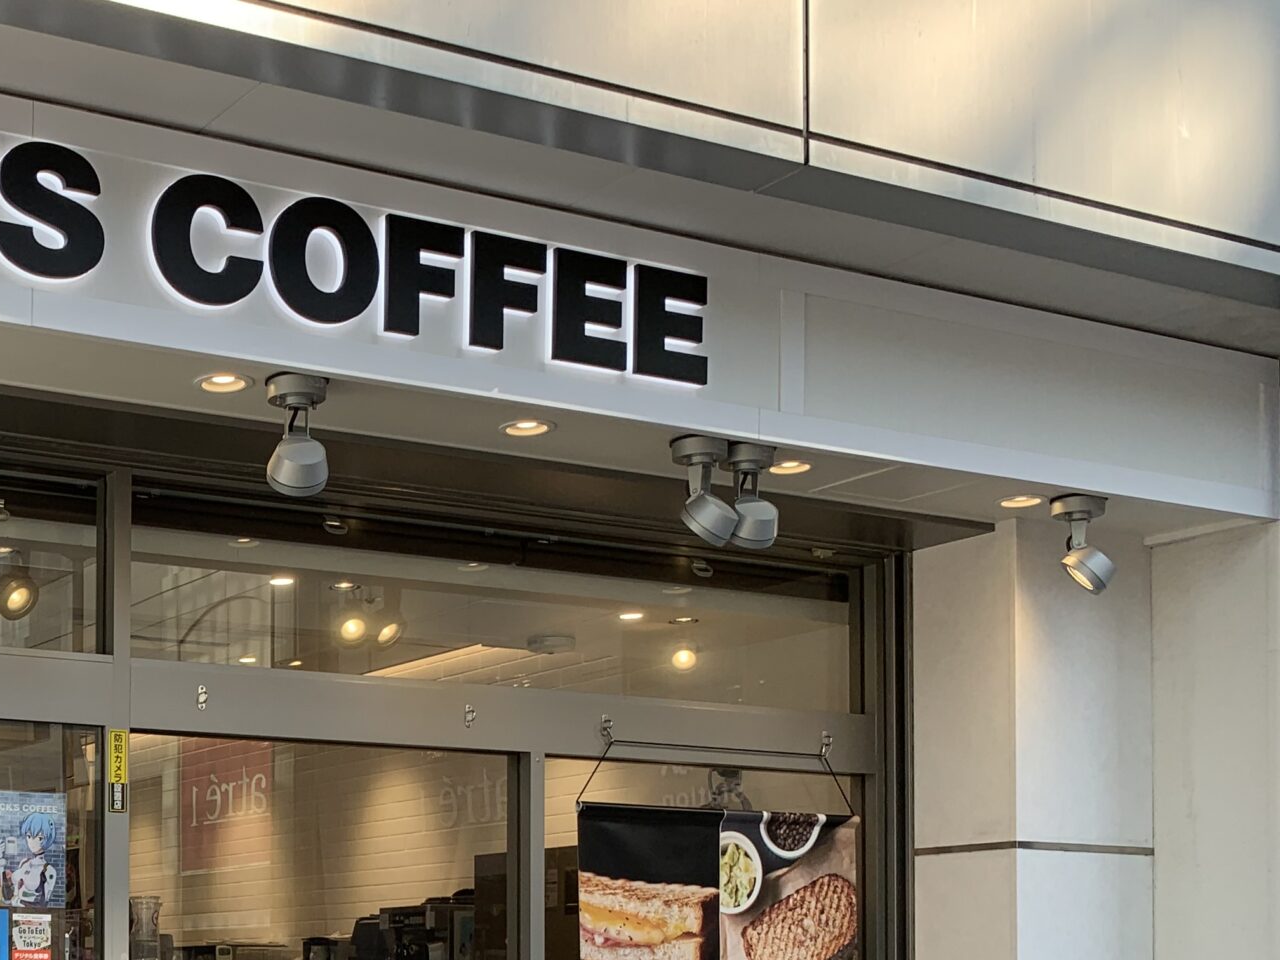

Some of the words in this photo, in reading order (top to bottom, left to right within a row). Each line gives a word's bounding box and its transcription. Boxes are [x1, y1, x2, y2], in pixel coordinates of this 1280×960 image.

[151, 173, 708, 386] COFFEE
[113, 733, 124, 783] 防犯カメラ
[22, 804, 59, 814] COFFEE
[18, 926, 27, 934] Go
[35, 927, 46, 935] Eat
[22, 941, 41, 949] Tokyo
